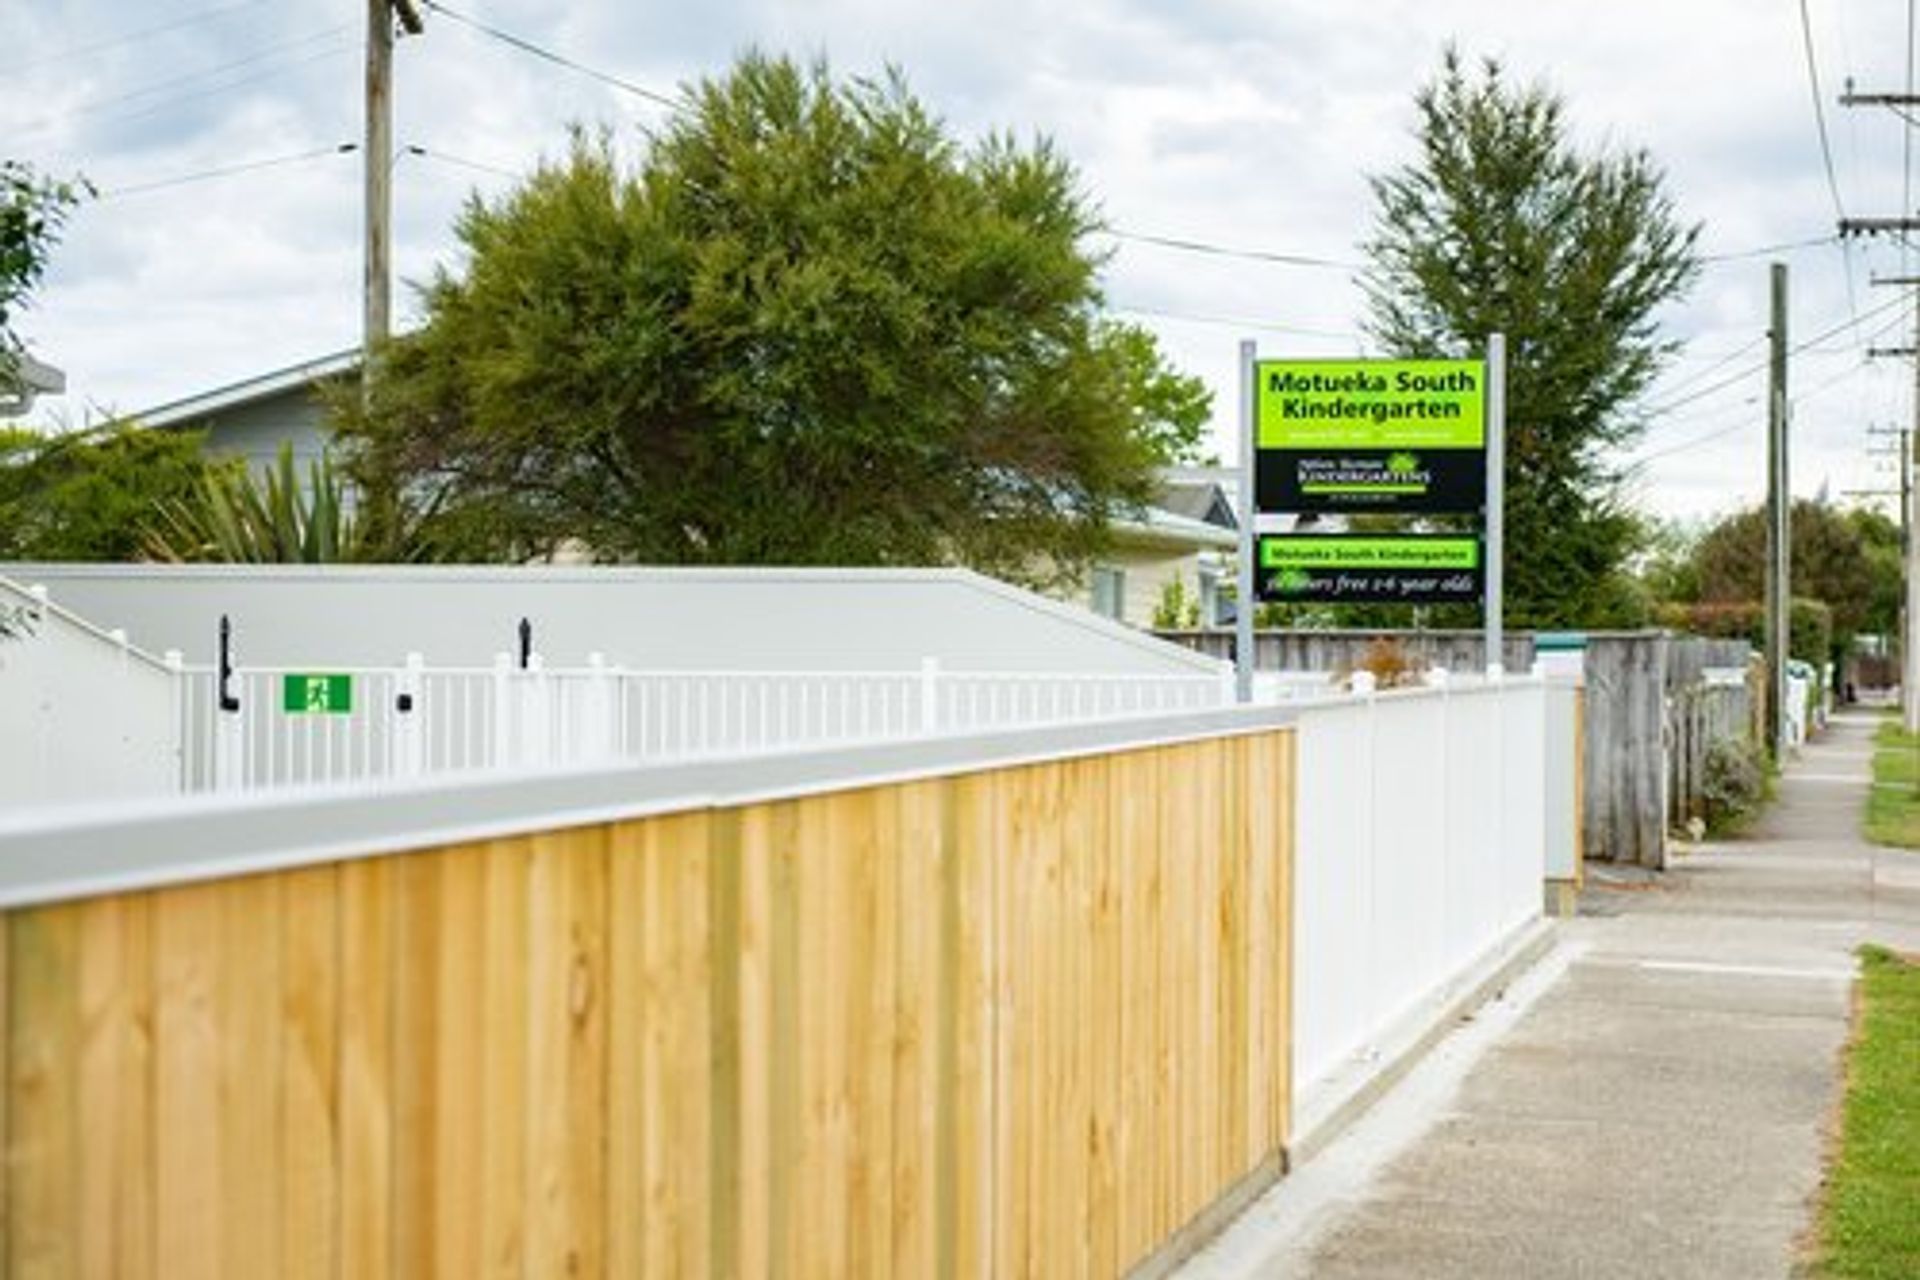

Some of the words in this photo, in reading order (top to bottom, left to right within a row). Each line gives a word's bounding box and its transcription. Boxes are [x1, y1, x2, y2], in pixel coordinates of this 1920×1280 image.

[1270, 372, 1387, 392] Motueka
[1396, 371, 1476, 392] South
[1283, 398, 1461, 424] Kindergarten
[1272, 548, 1330, 561] Motueka
[1335, 548, 1374, 561] South
[1379, 548, 1468, 564] Kindergarten
[1333, 574, 1368, 595] free
[1401, 577, 1438, 596] year
[1441, 575, 1474, 592] olds
